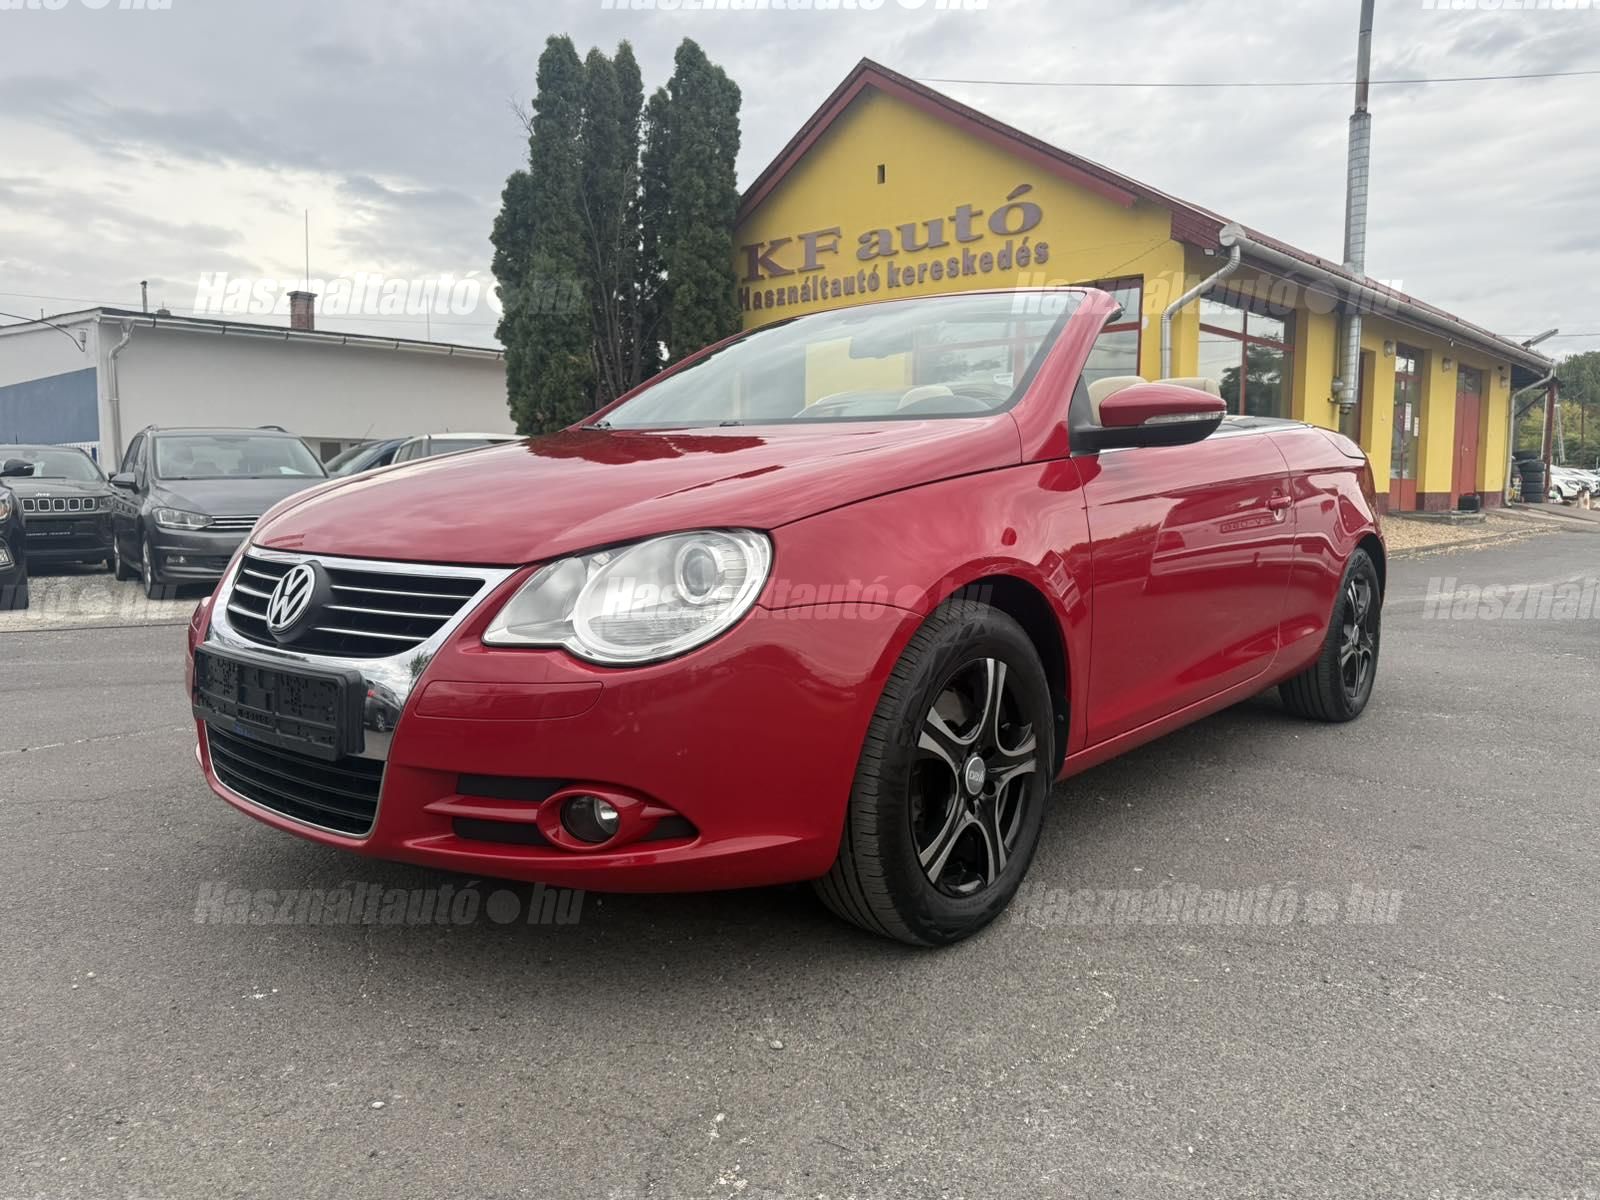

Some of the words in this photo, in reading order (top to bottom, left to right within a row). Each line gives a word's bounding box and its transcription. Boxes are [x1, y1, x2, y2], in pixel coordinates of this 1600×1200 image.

[738, 264, 880, 311] Használtautó
[887, 236, 1049, 288] kereskedés
[741, 226, 842, 281] KF
[856, 183, 1042, 260] autó
